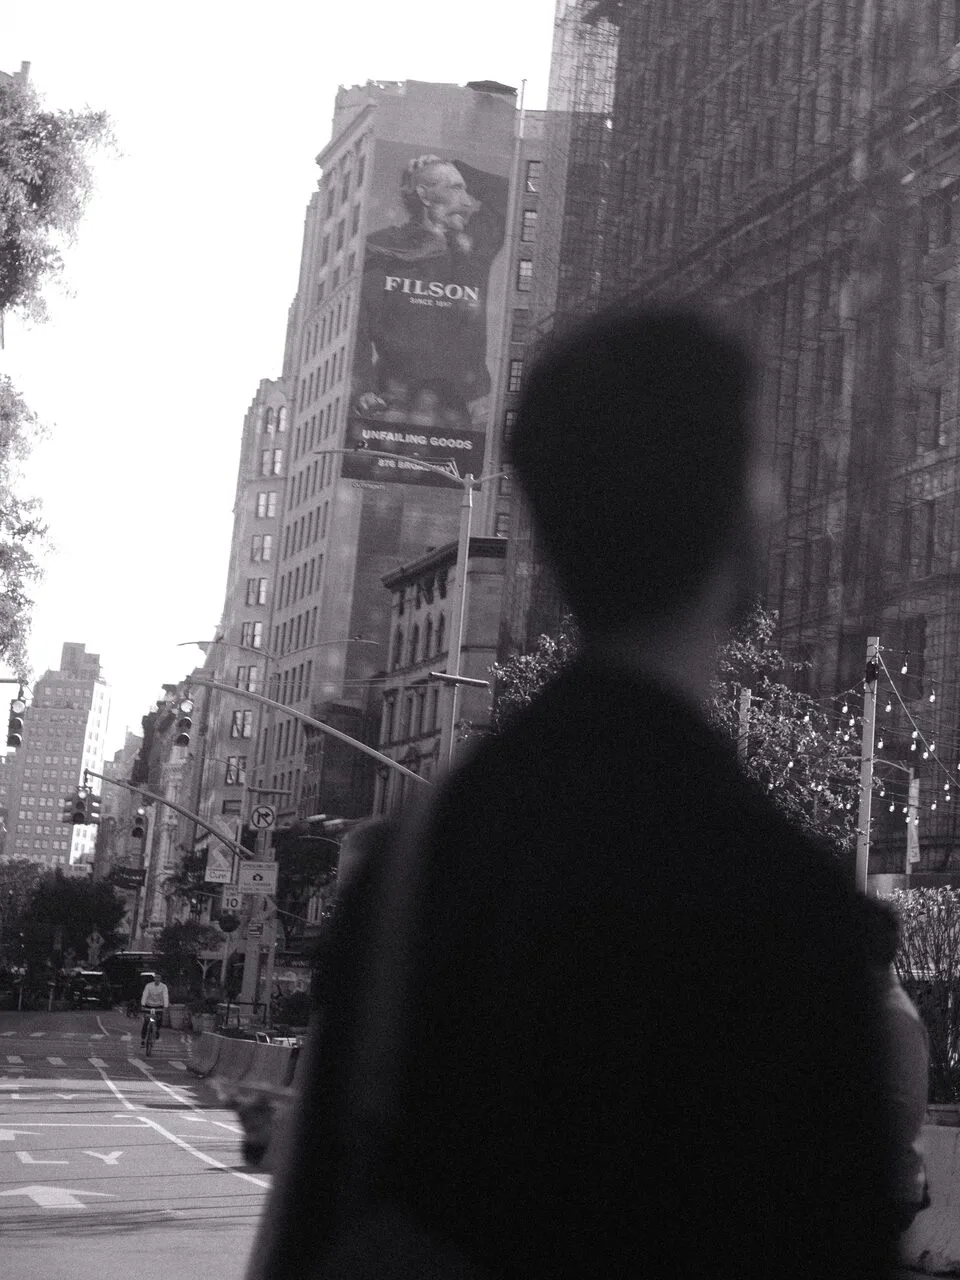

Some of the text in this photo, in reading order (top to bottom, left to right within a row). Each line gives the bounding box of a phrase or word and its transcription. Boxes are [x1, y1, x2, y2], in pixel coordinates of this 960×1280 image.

[384, 275, 479, 301] FILSON
[361, 429, 473, 451] UNFAILING GOODS
[225, 898, 240, 908] 10
